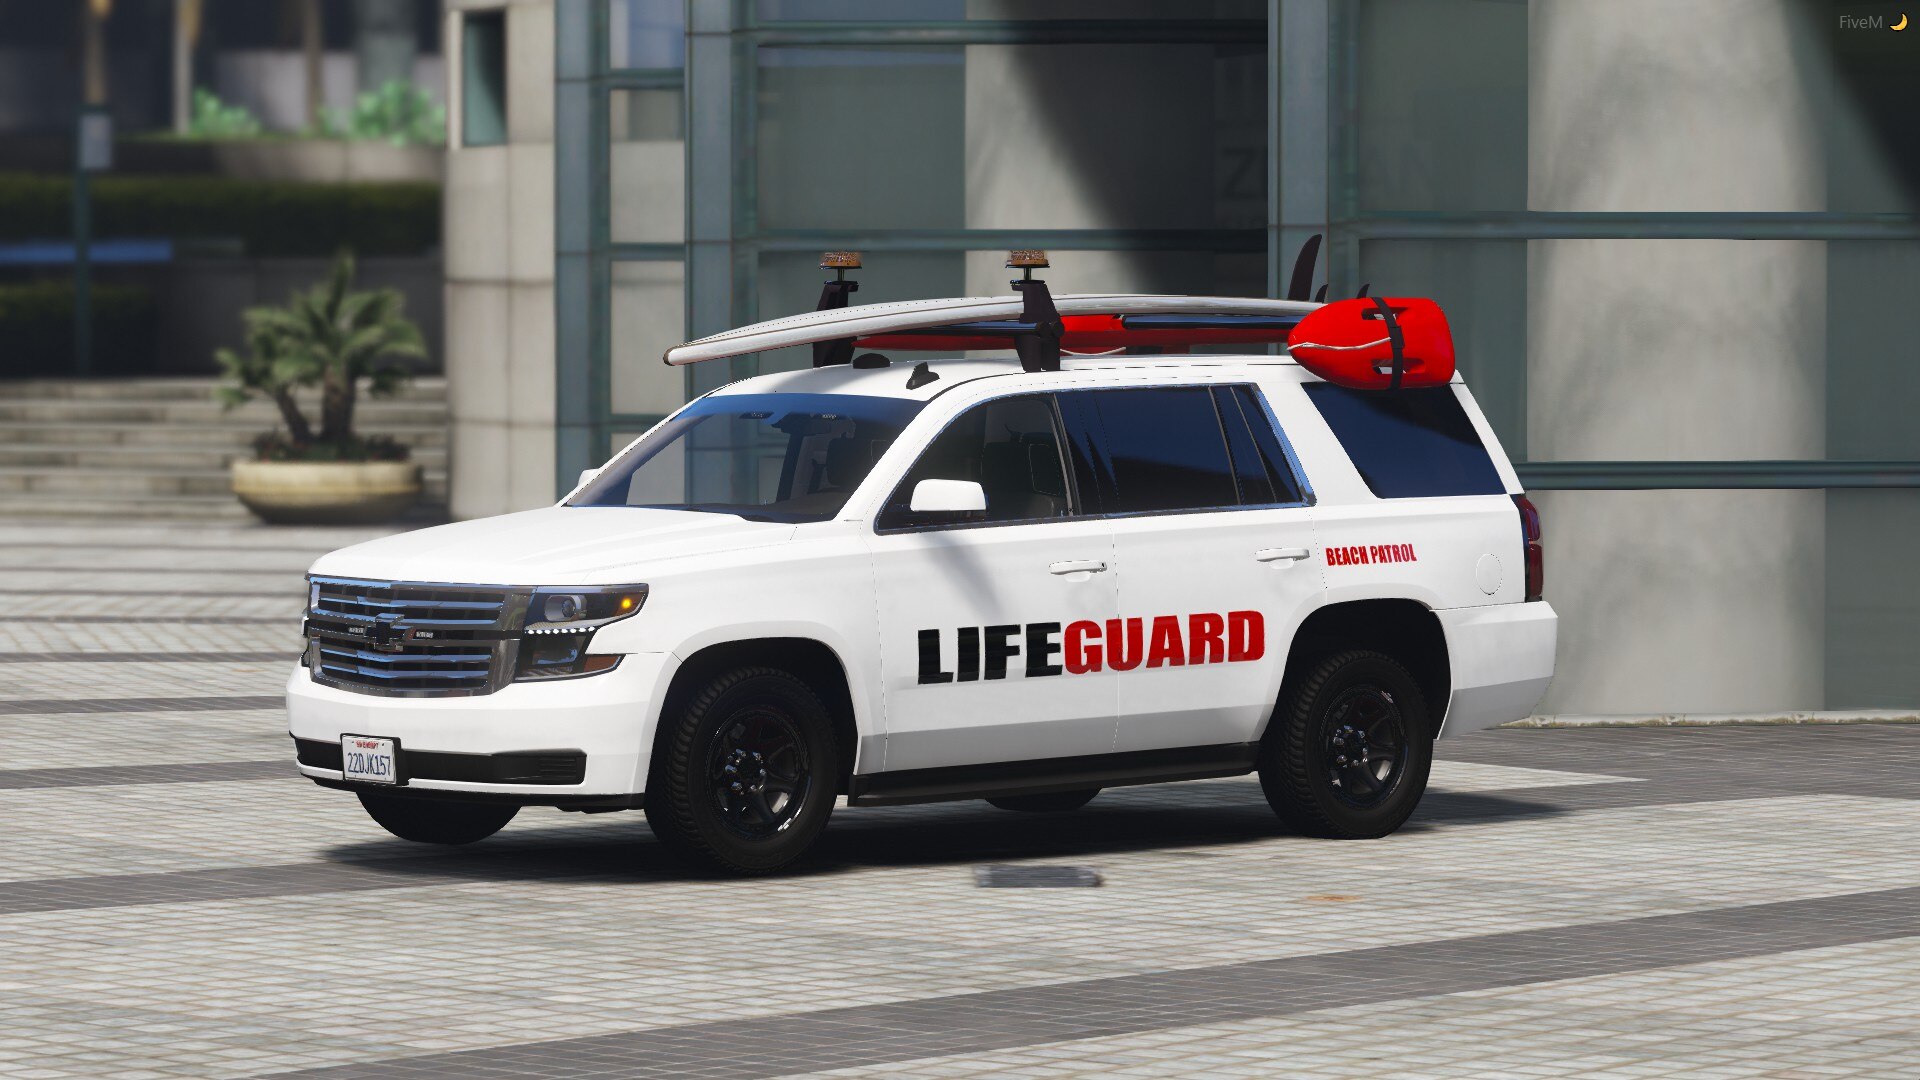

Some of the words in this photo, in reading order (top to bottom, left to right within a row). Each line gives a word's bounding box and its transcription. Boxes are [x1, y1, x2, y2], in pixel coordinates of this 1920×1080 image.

[1326, 545, 1369, 566] BEACH
[1370, 543, 1416, 564] PATROL
[917, 610, 1265, 685] LIFEGUARD
